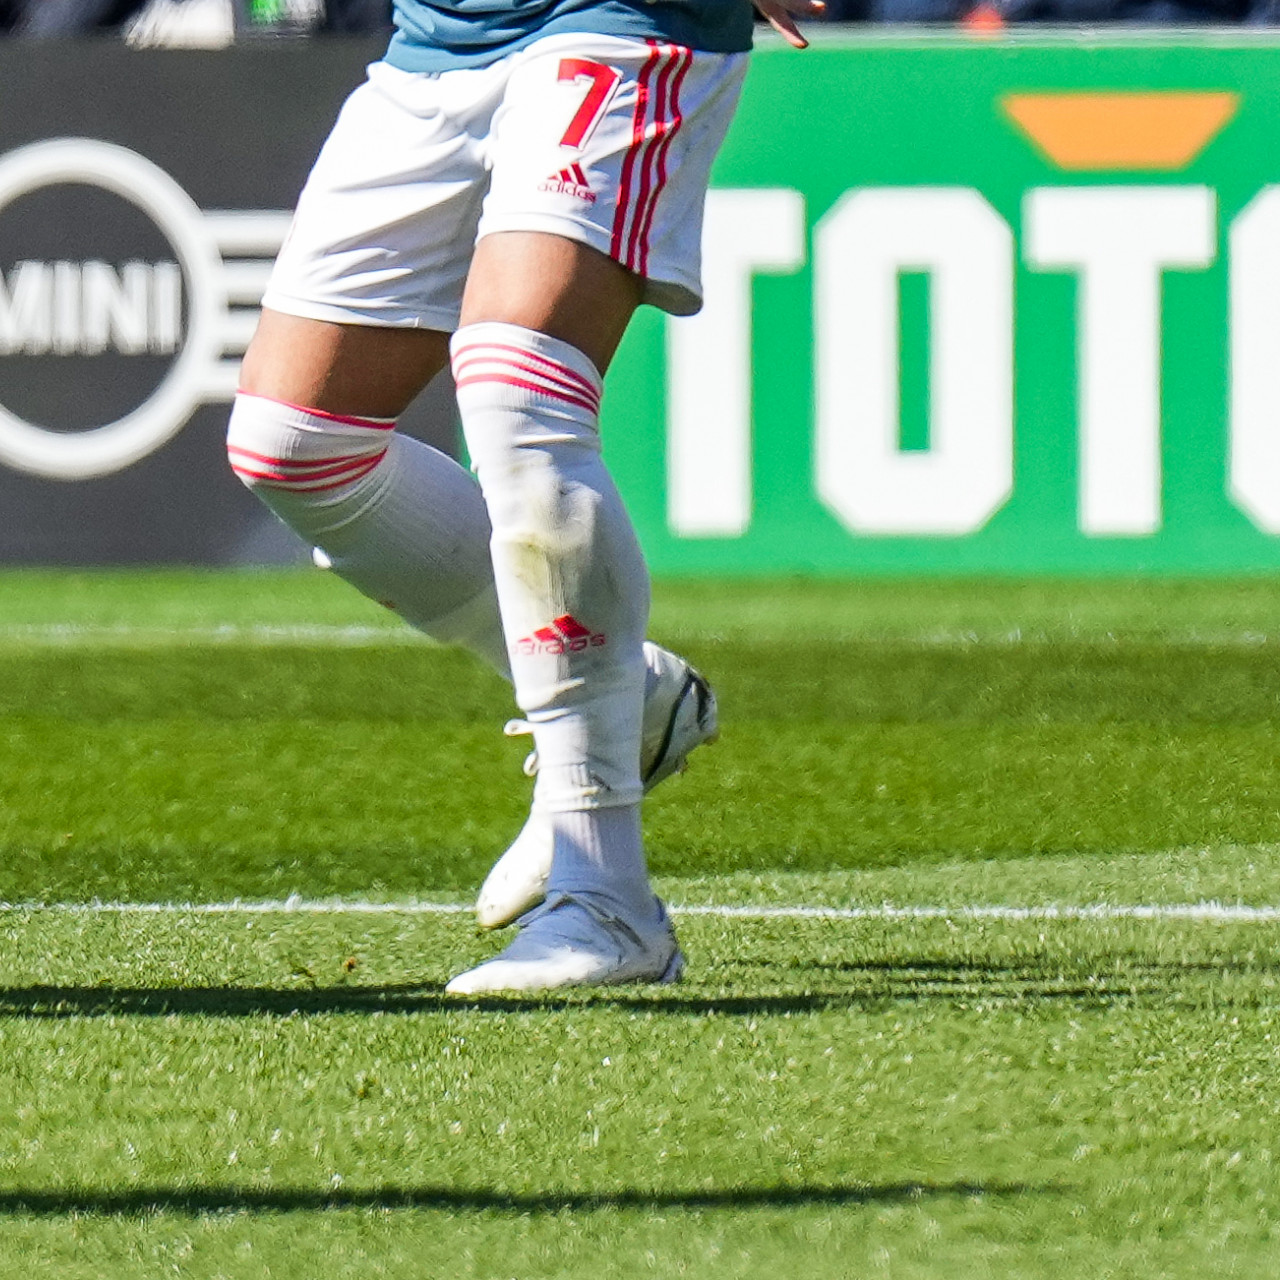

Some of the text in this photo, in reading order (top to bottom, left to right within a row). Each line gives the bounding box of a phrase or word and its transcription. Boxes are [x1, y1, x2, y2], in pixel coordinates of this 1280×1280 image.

[556, 57, 624, 152] 7
[538, 178, 596, 202] adidas
[667, 184, 1280, 538] TOT
[510, 634, 605, 656] adidas
